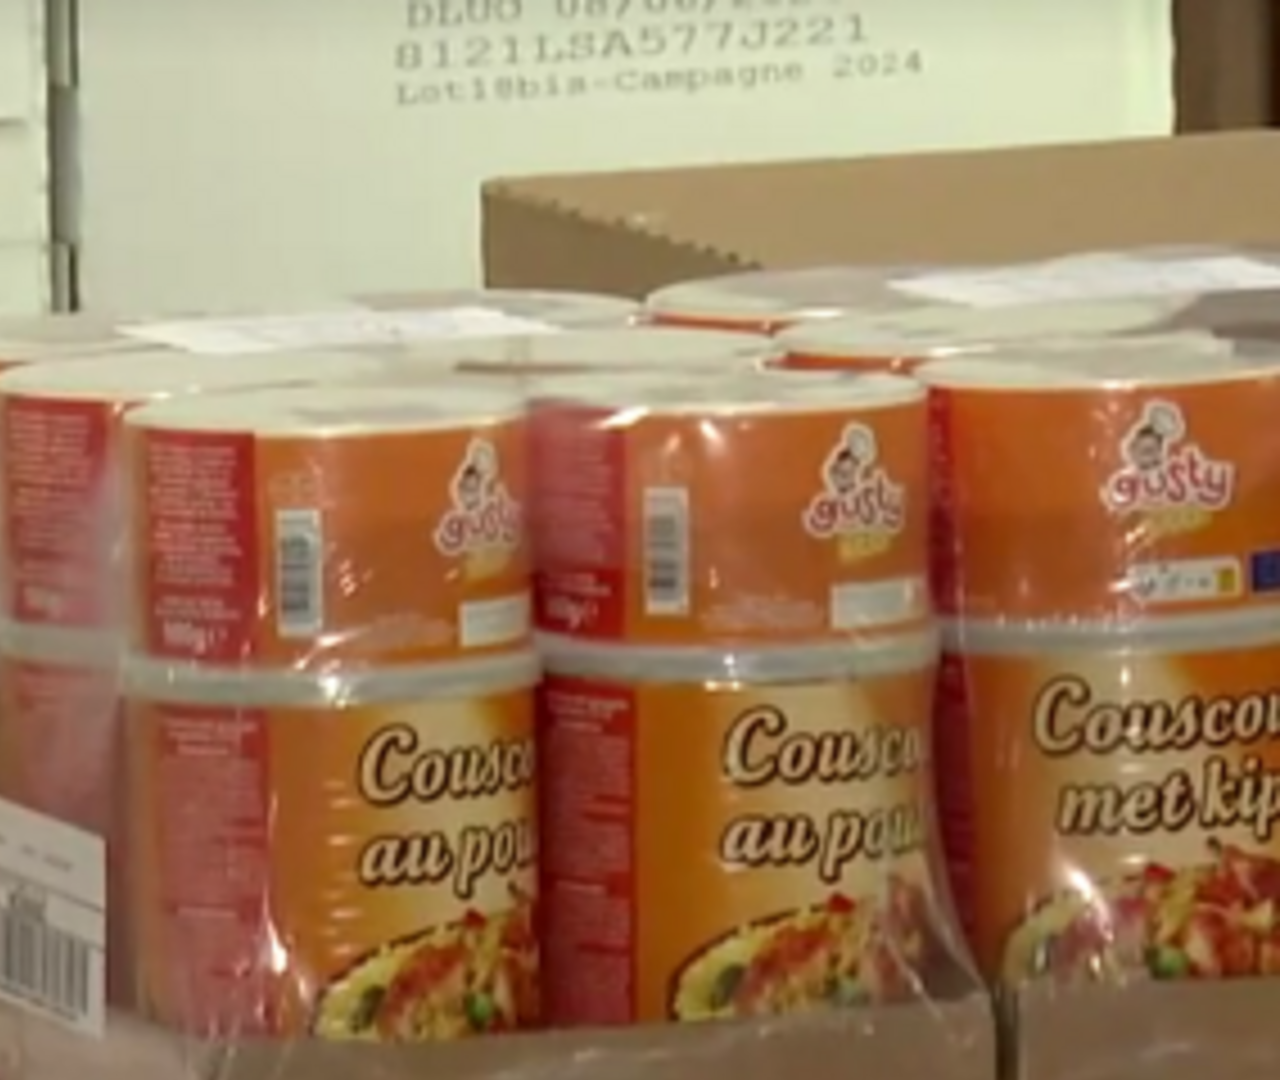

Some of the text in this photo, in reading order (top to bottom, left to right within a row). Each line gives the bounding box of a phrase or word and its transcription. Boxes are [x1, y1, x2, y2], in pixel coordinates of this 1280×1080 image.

[832, 49, 923, 79] 2024
[1111, 448, 1227, 507] gusty
[720, 703, 924, 789] Cousco
[1033, 674, 1280, 759] Cousco
[1055, 754, 1280, 842] met kip
[357, 831, 454, 887] au
[720, 811, 821, 868] au
